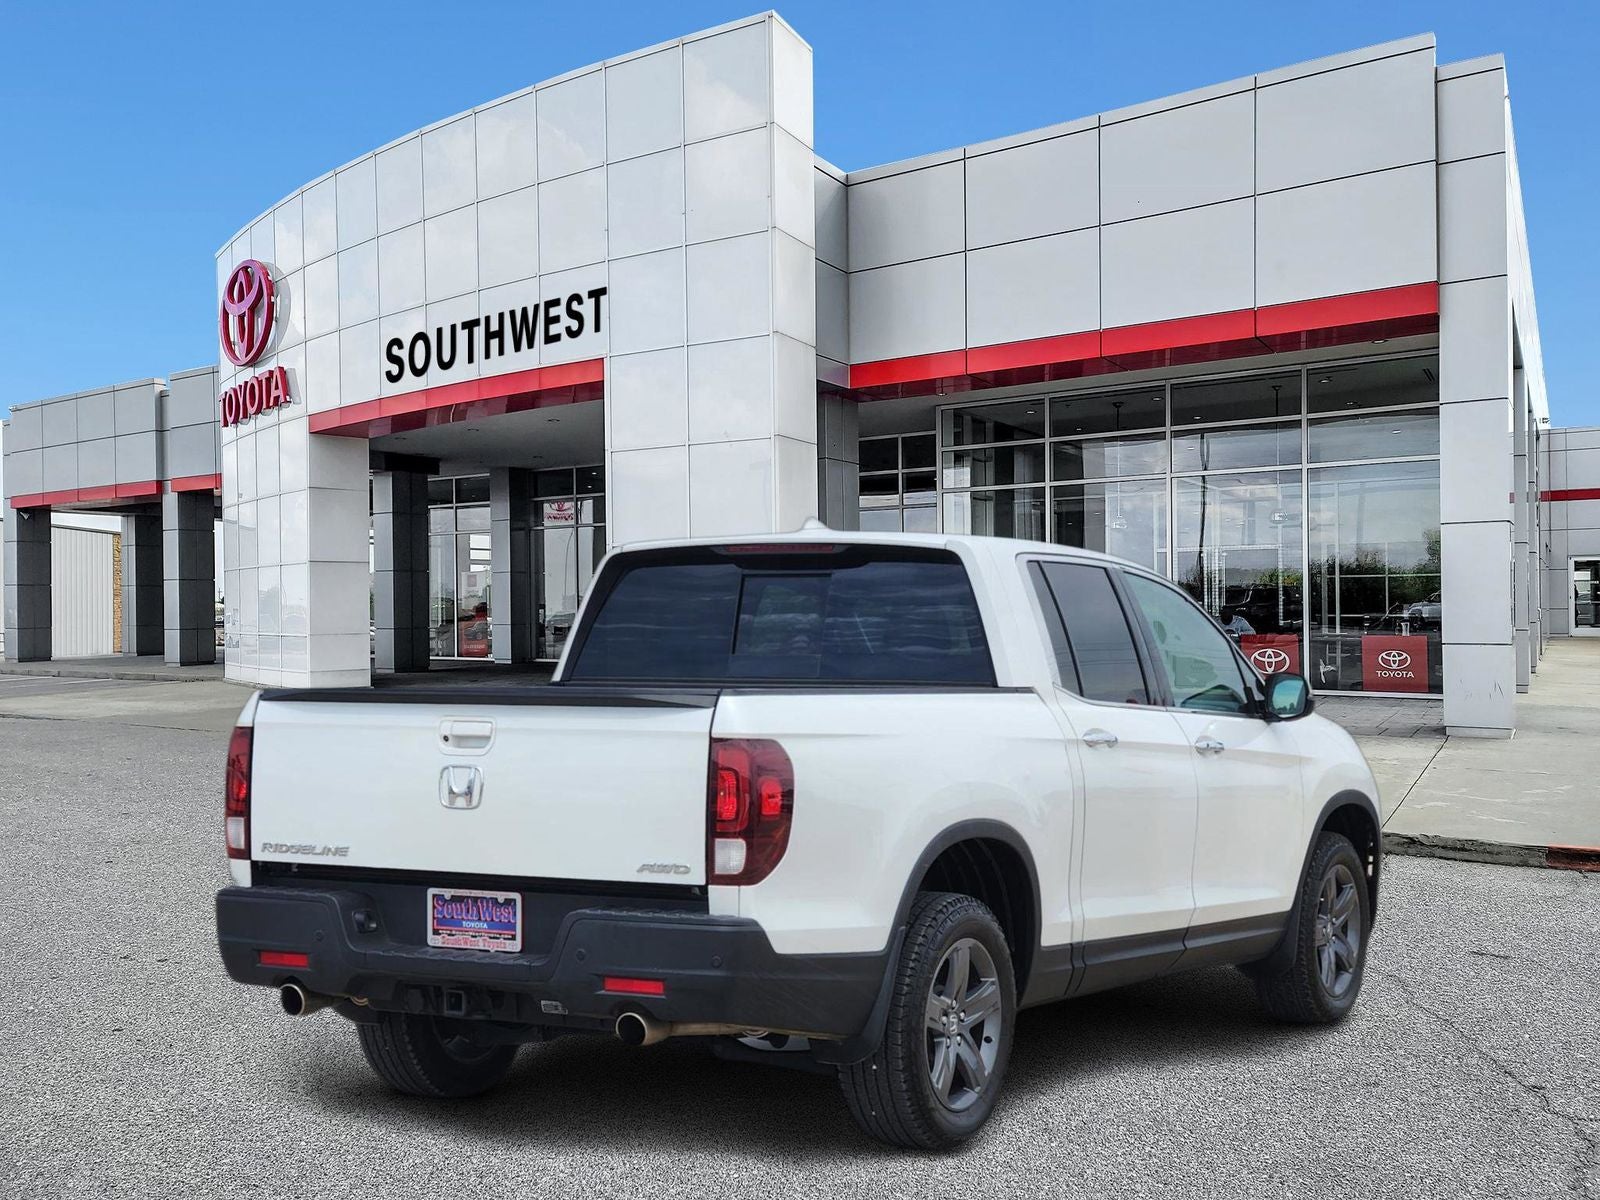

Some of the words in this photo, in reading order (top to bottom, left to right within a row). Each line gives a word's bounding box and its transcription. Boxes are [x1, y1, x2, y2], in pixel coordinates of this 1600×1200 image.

[385, 286, 608, 384] SOUTHWEST
[218, 365, 292, 428] TOYOTA
[1375, 670, 1415, 678] TOYOTA
[261, 842, 350, 857] RIDGELINE
[636, 862, 692, 875] AWD
[462, 921, 489, 929] TOYOTA
